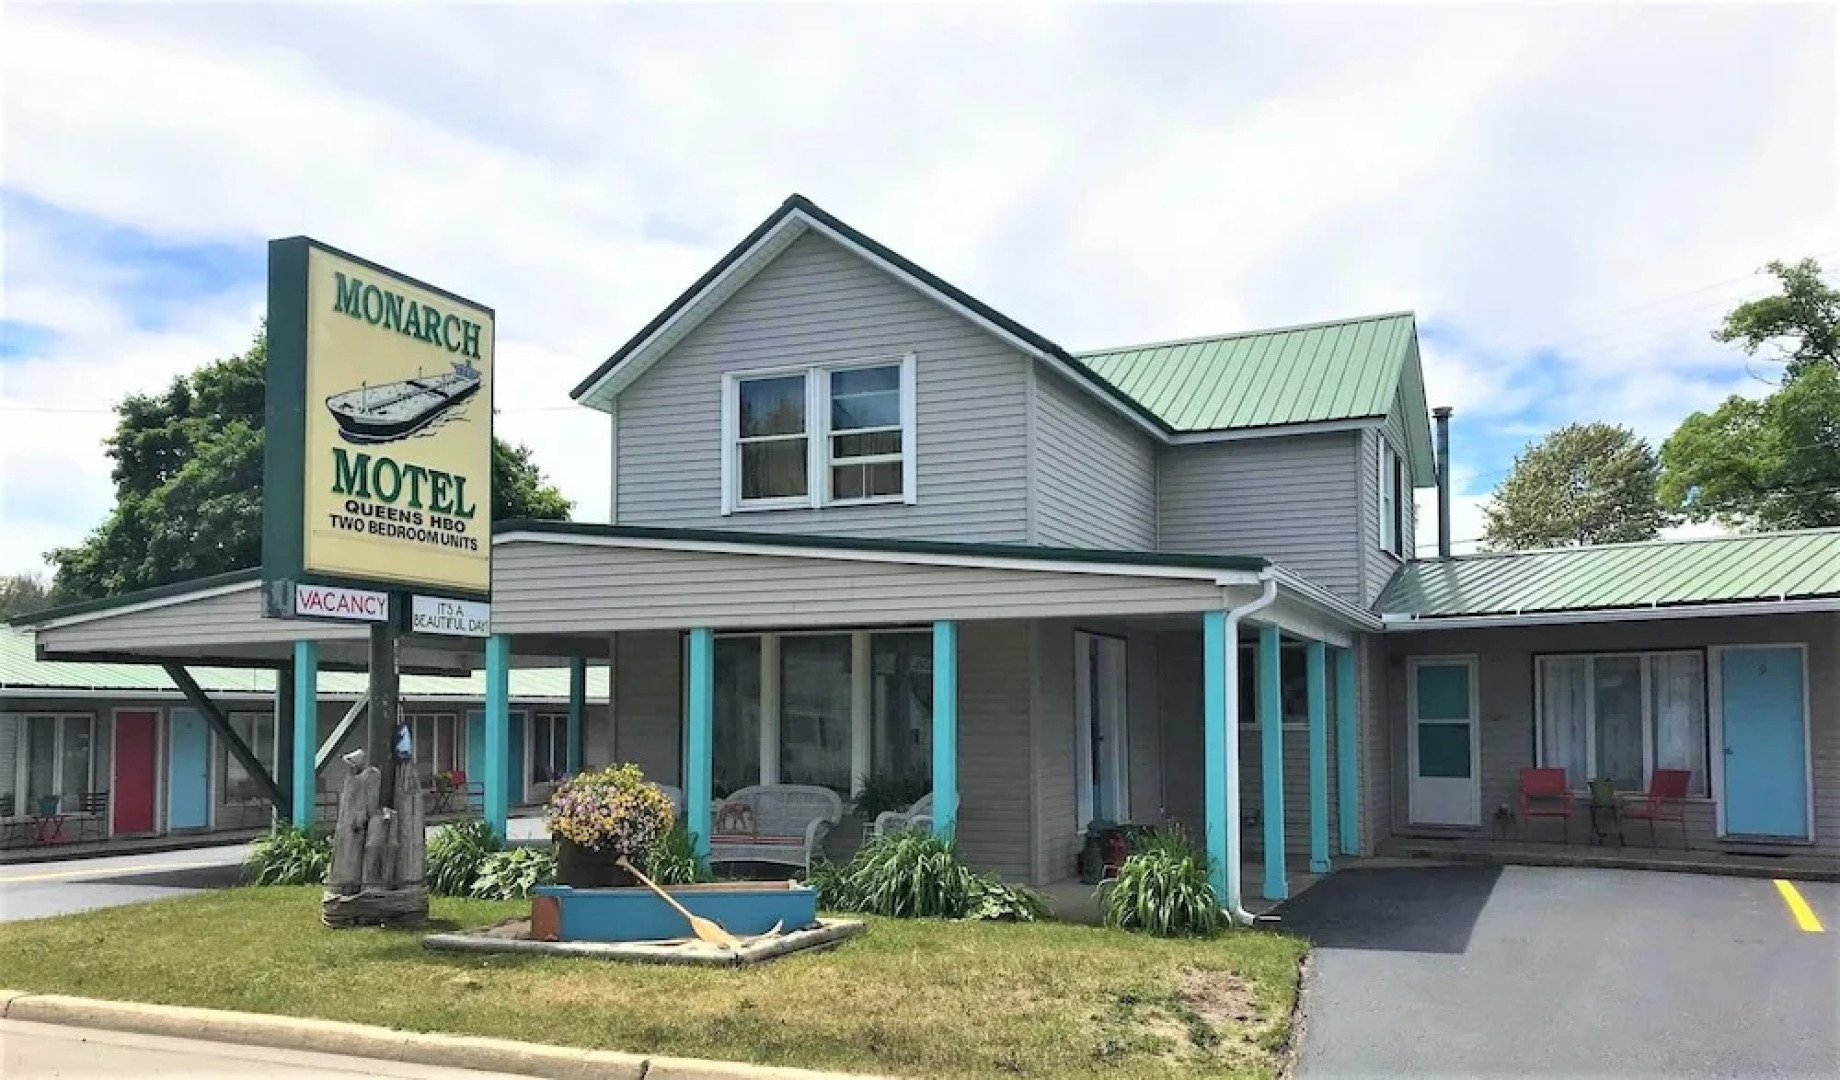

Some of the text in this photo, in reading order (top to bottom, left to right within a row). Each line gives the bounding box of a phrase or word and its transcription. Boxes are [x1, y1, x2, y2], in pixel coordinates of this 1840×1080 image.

[333, 271, 481, 360] MONARCH
[332, 447, 476, 519] MOTEL
[345, 500, 466, 533] QUEENS HBO
[329, 513, 478, 551] TWO BEDROOM UNITS
[299, 590, 386, 616] VACANCY
[456, 604, 465, 617] A
[413, 614, 466, 631] BEAUTIFUL
[1758, 663, 1767, 677] 9
